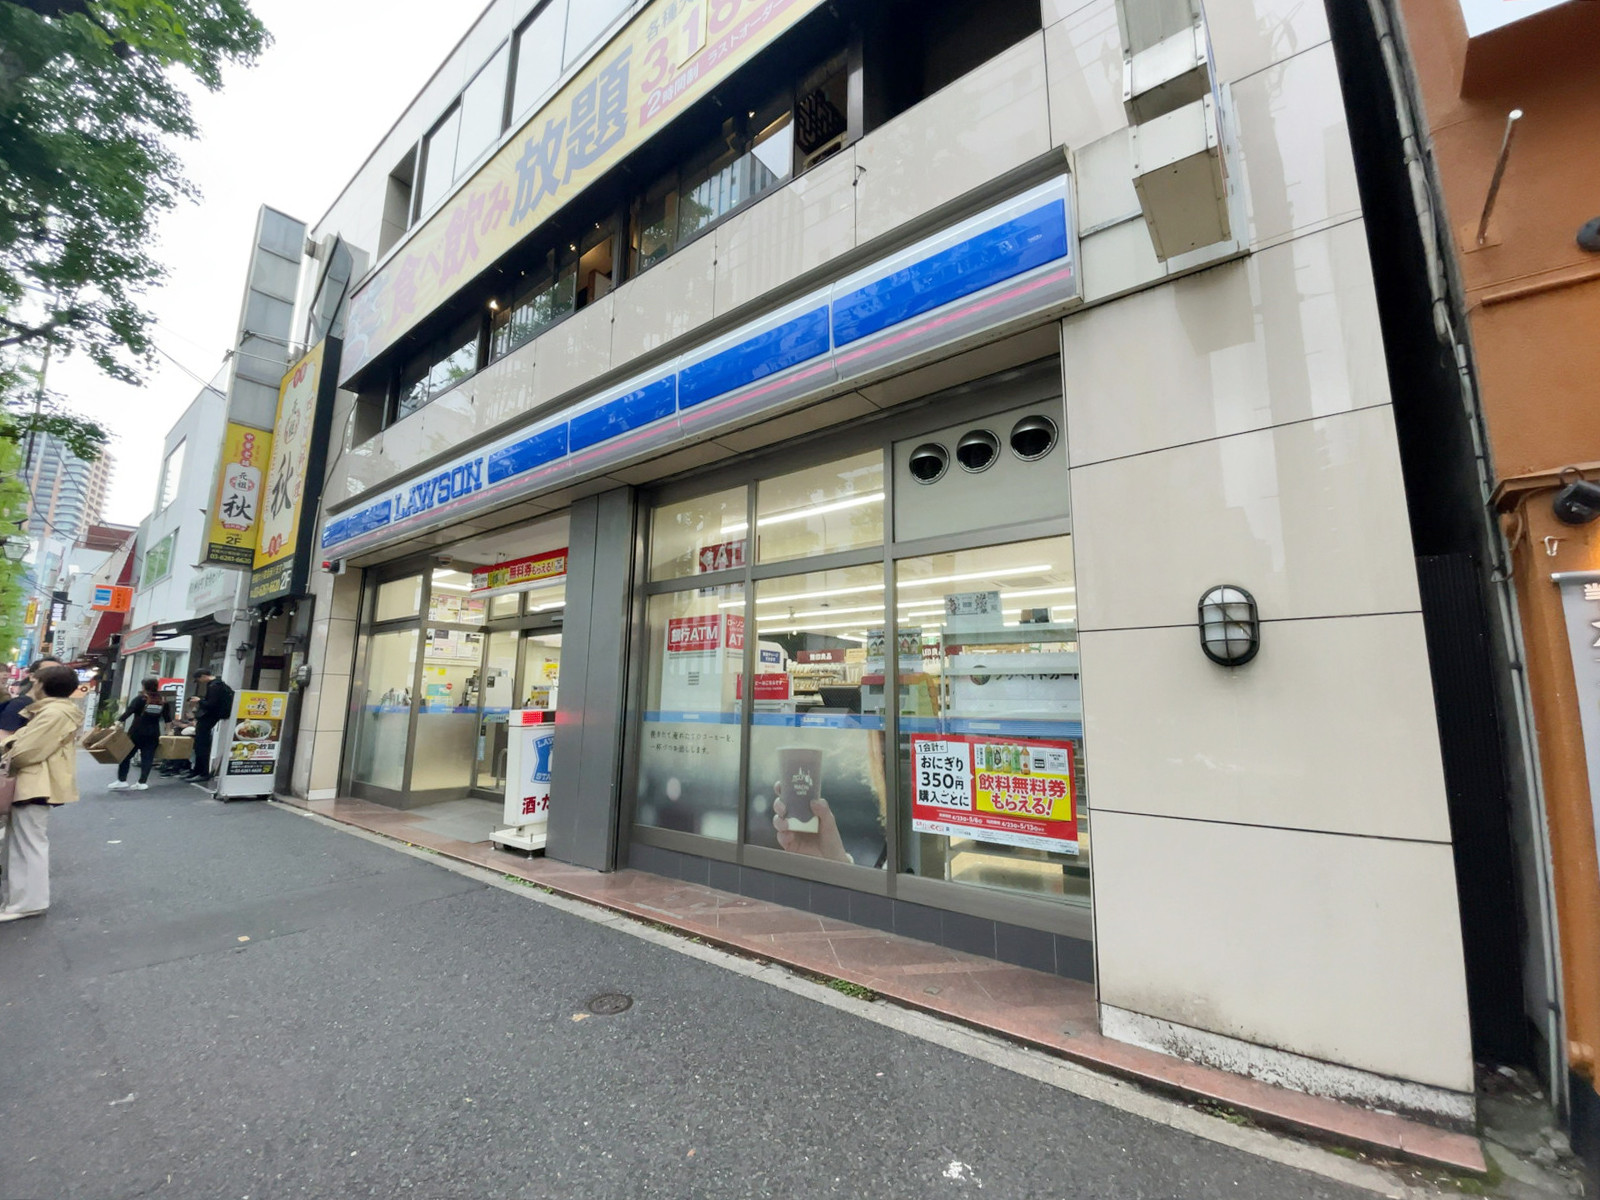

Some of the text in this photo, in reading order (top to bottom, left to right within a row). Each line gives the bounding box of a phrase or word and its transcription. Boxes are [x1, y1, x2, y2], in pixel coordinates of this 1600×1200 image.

[385, 45, 633, 333] 食べ飲み放題
[271, 451, 295, 521] 秋
[392, 456, 484, 521] LAWSON
[222, 494, 254, 521] 秋
[225, 536, 242, 545] 2F
[279, 569, 293, 591] 2F
[671, 625, 718, 643] 銀行ATM
[918, 742, 945, 752] 1会計で
[921, 755, 964, 772] おにぎり
[921, 771, 964, 790] 350円
[978, 773, 1066, 798] 飲料無料券
[918, 789, 970, 807] 購入ごとに
[991, 793, 1054, 816] もらえる!
